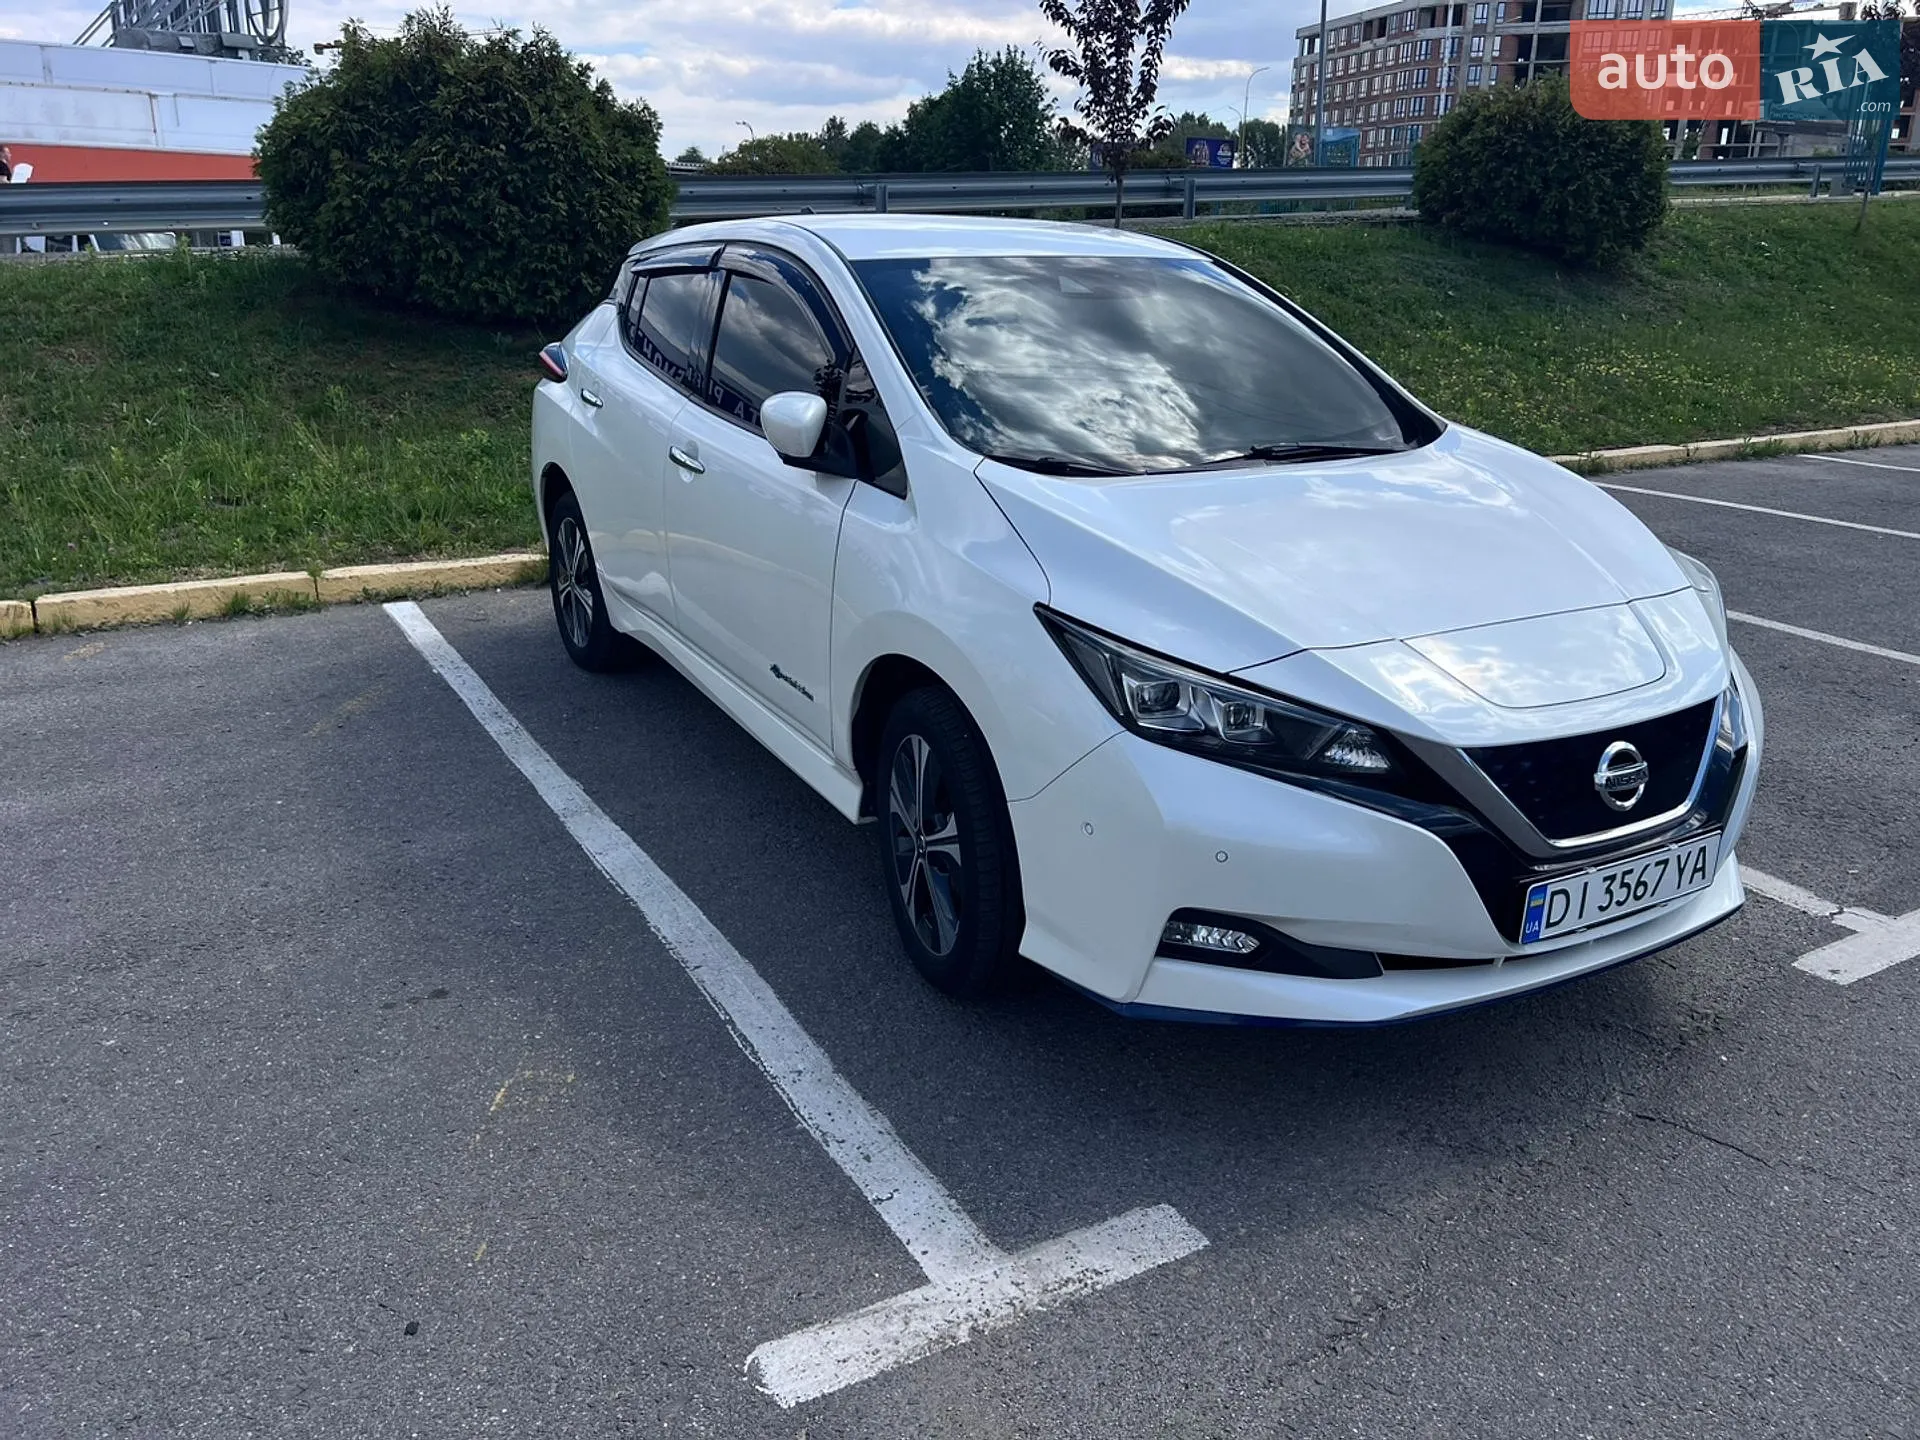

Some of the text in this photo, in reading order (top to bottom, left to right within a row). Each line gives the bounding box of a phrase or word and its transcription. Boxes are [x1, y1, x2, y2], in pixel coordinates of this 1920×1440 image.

[1545, 845, 1707, 929] DI 3567 YA
[1525, 920, 1540, 933] UA
